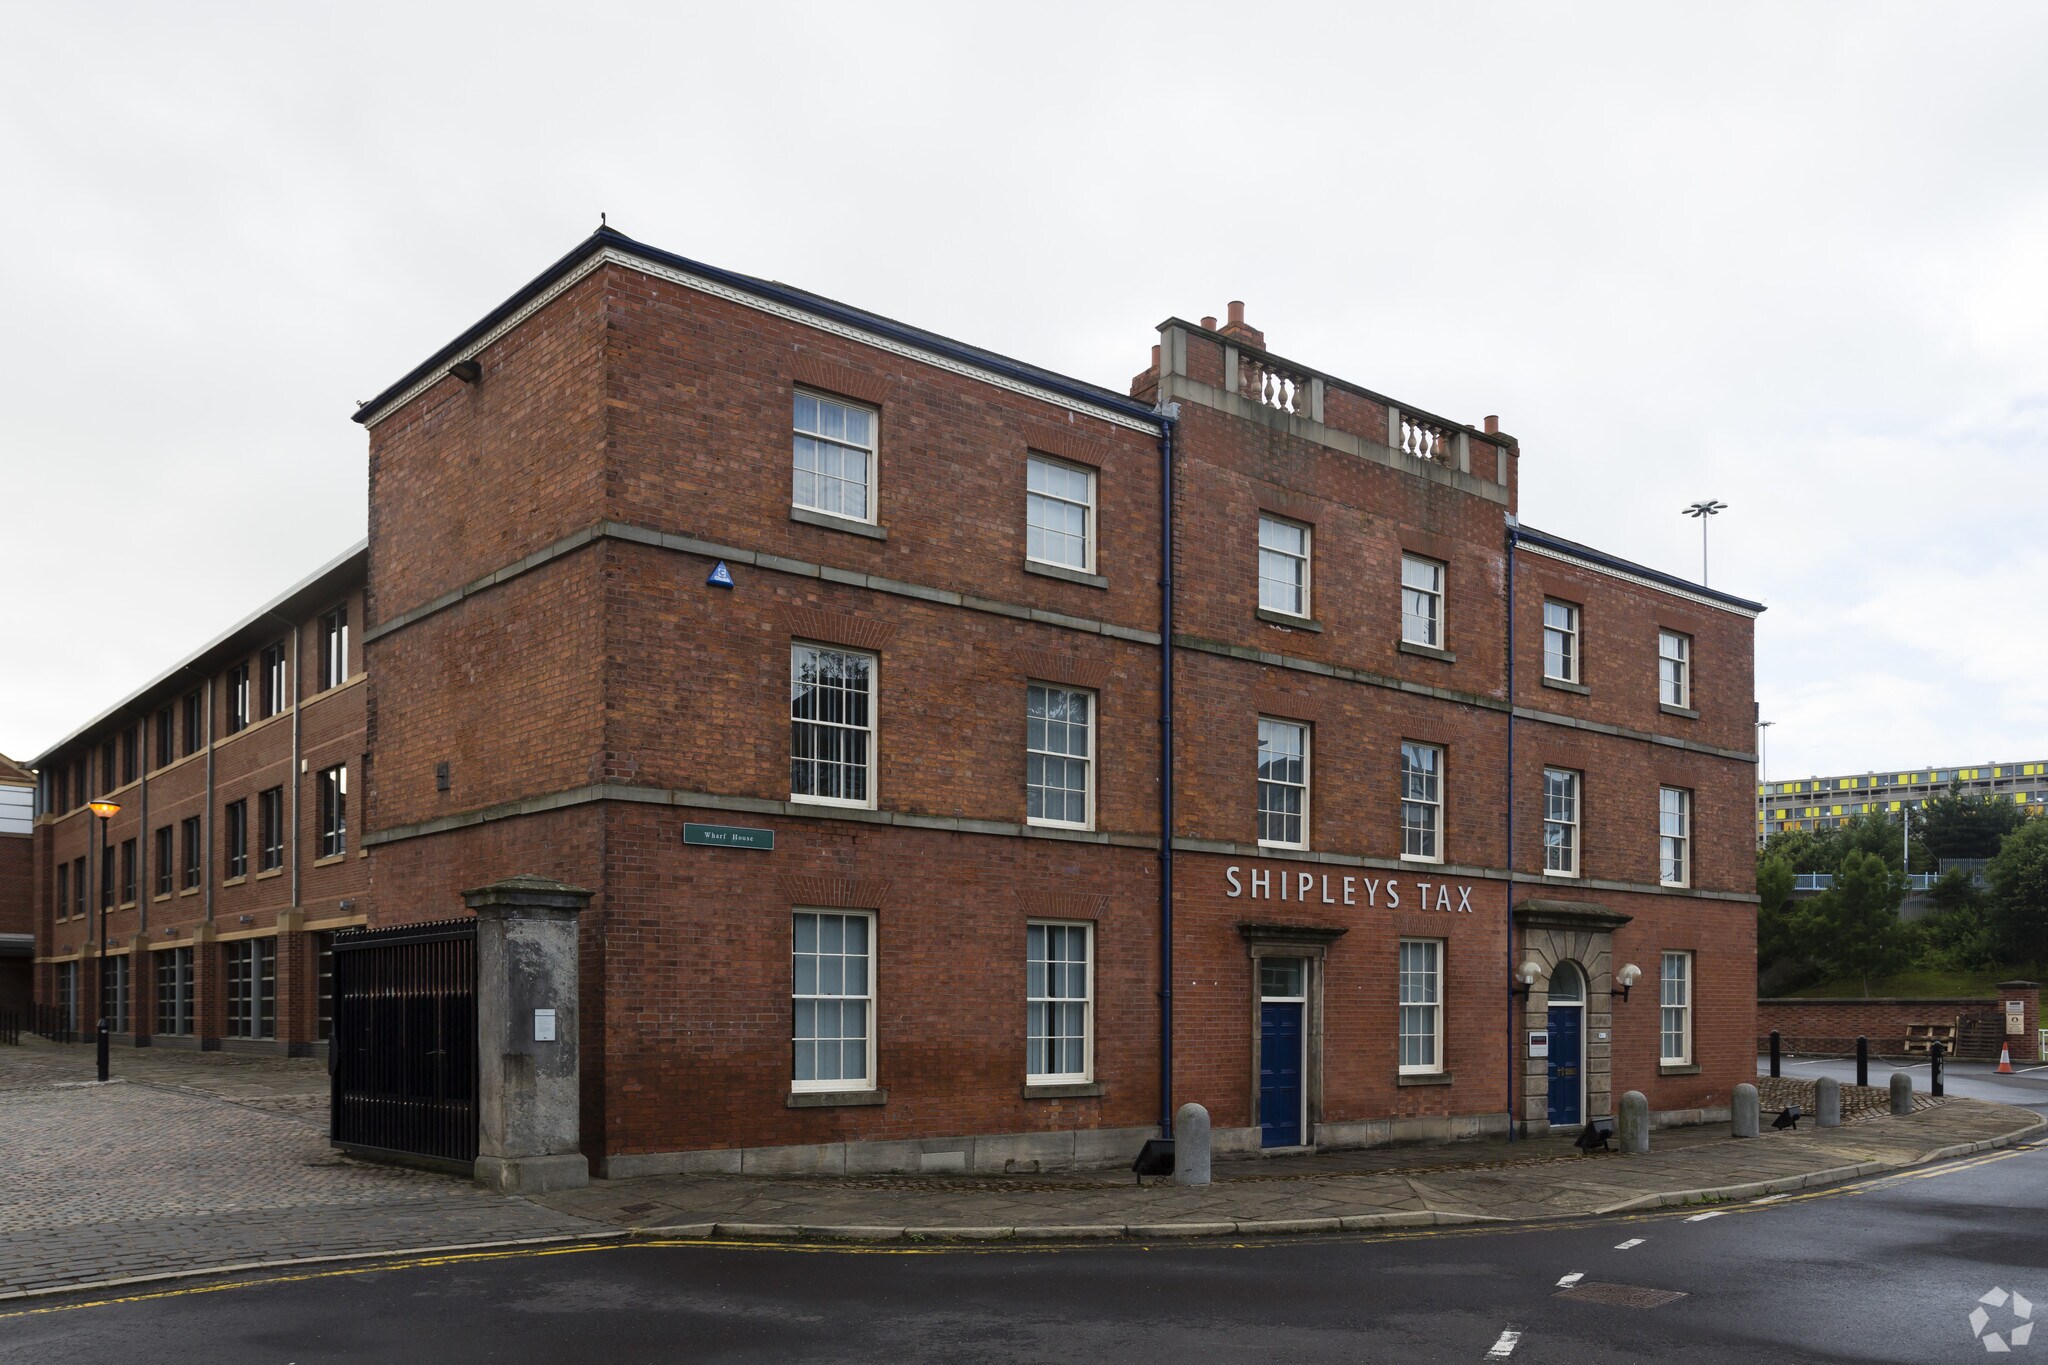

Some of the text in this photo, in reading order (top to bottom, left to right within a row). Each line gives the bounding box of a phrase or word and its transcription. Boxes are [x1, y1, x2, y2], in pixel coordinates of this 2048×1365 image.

[704, 831, 754, 842] Wharf House
[1226, 866, 1473, 913] SHIPLEYS TAX
